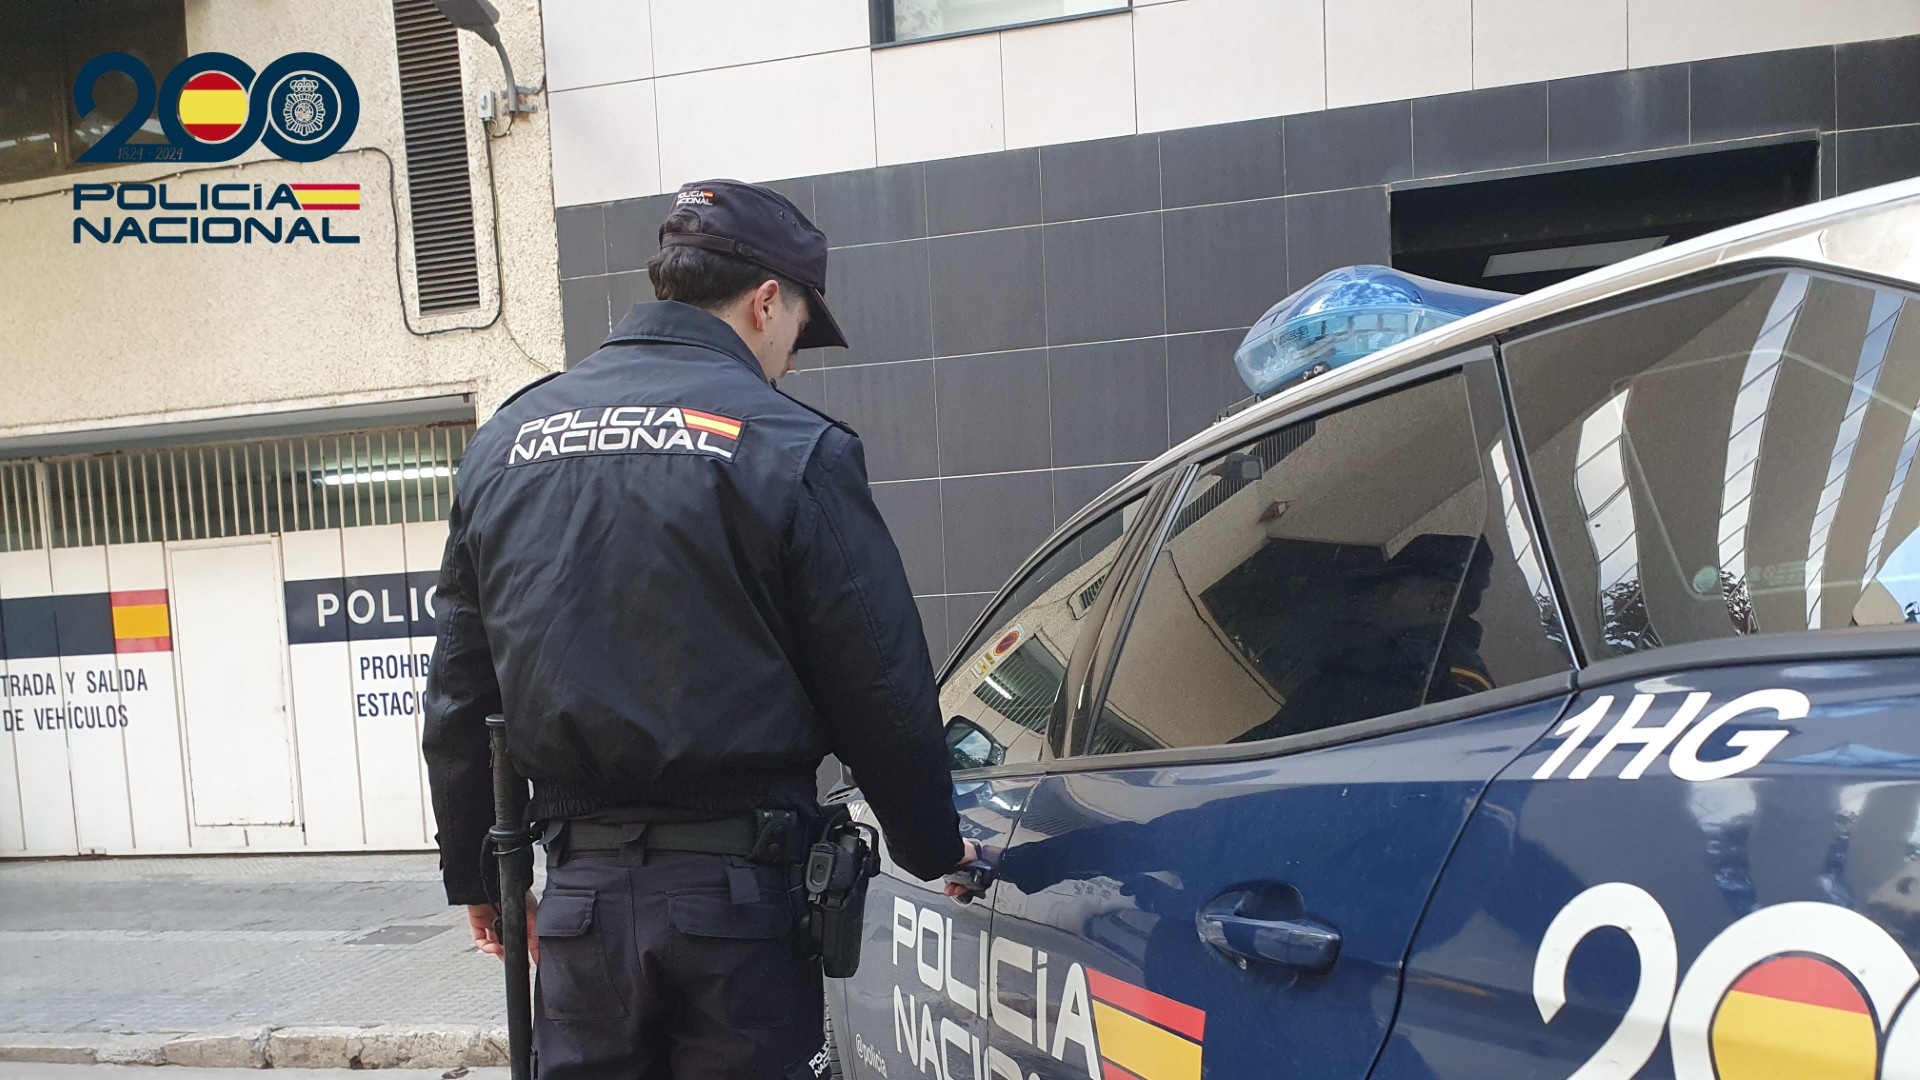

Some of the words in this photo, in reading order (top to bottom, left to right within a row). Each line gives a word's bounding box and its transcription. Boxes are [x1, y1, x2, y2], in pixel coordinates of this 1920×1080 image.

[508, 427, 733, 465] NACIONAL
[65, 671, 75, 694] Y
[86, 668, 148, 693] SALIDA
[3, 709, 25, 732] DE
[34, 701, 129, 731] VEHÍCULOS
[1531, 688, 1811, 782] 1HG
[1533, 882, 1920, 1080] 20
[893, 985, 1041, 1080] NACI
